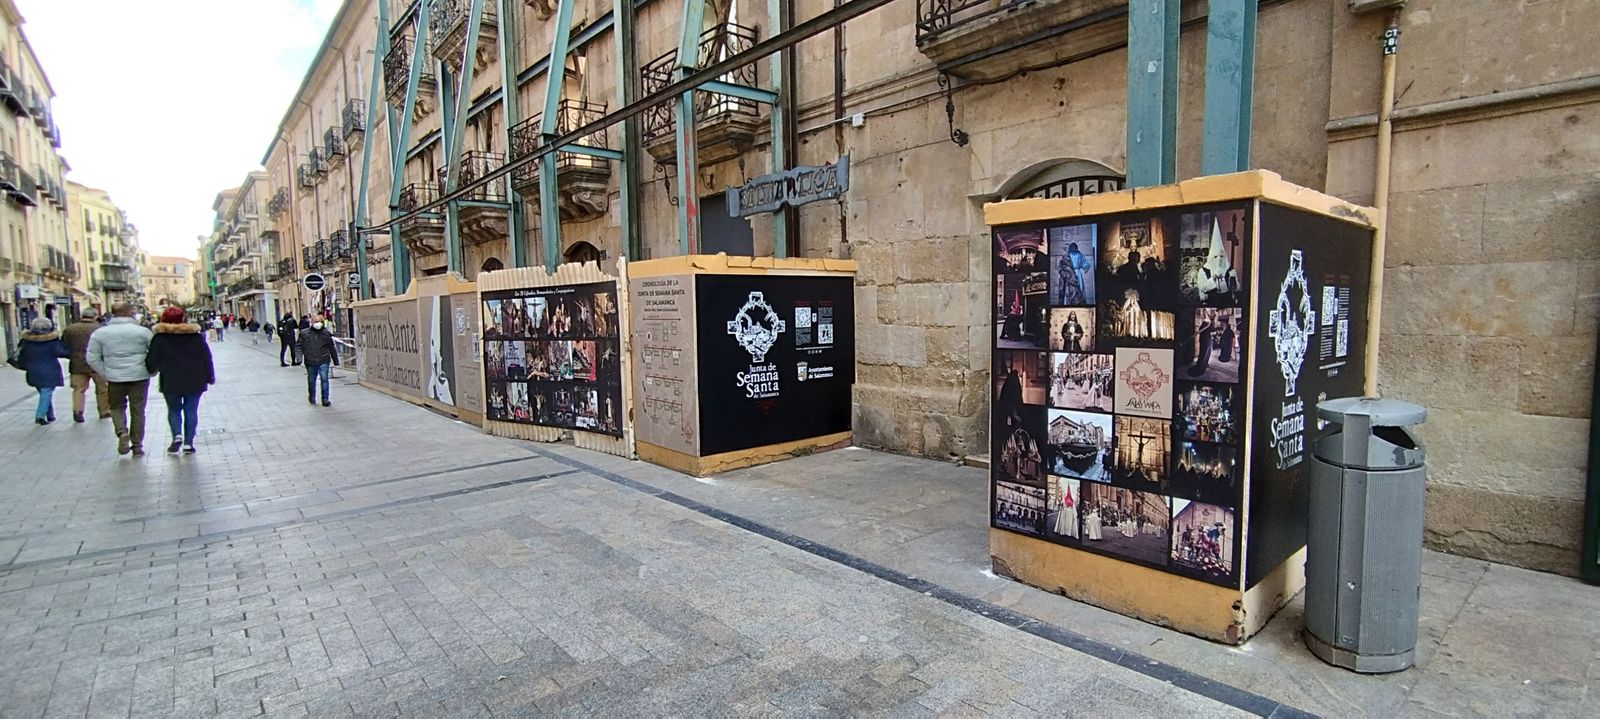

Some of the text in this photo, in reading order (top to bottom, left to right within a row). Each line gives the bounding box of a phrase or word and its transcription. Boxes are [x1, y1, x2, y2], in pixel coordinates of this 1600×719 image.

[1385, 29, 1398, 37] CT
[357, 310, 389, 351] Semana
[388, 306, 419, 354] Santa
[377, 353, 421, 390] de Salamanca
[736, 371, 779, 387] Semana
[749, 362, 777, 374] Junta de
[746, 381, 779, 398] Santa
[1281, 396, 1304, 422] Junta de
[1270, 414, 1304, 448] Semana
[1276, 434, 1304, 470] Santa
